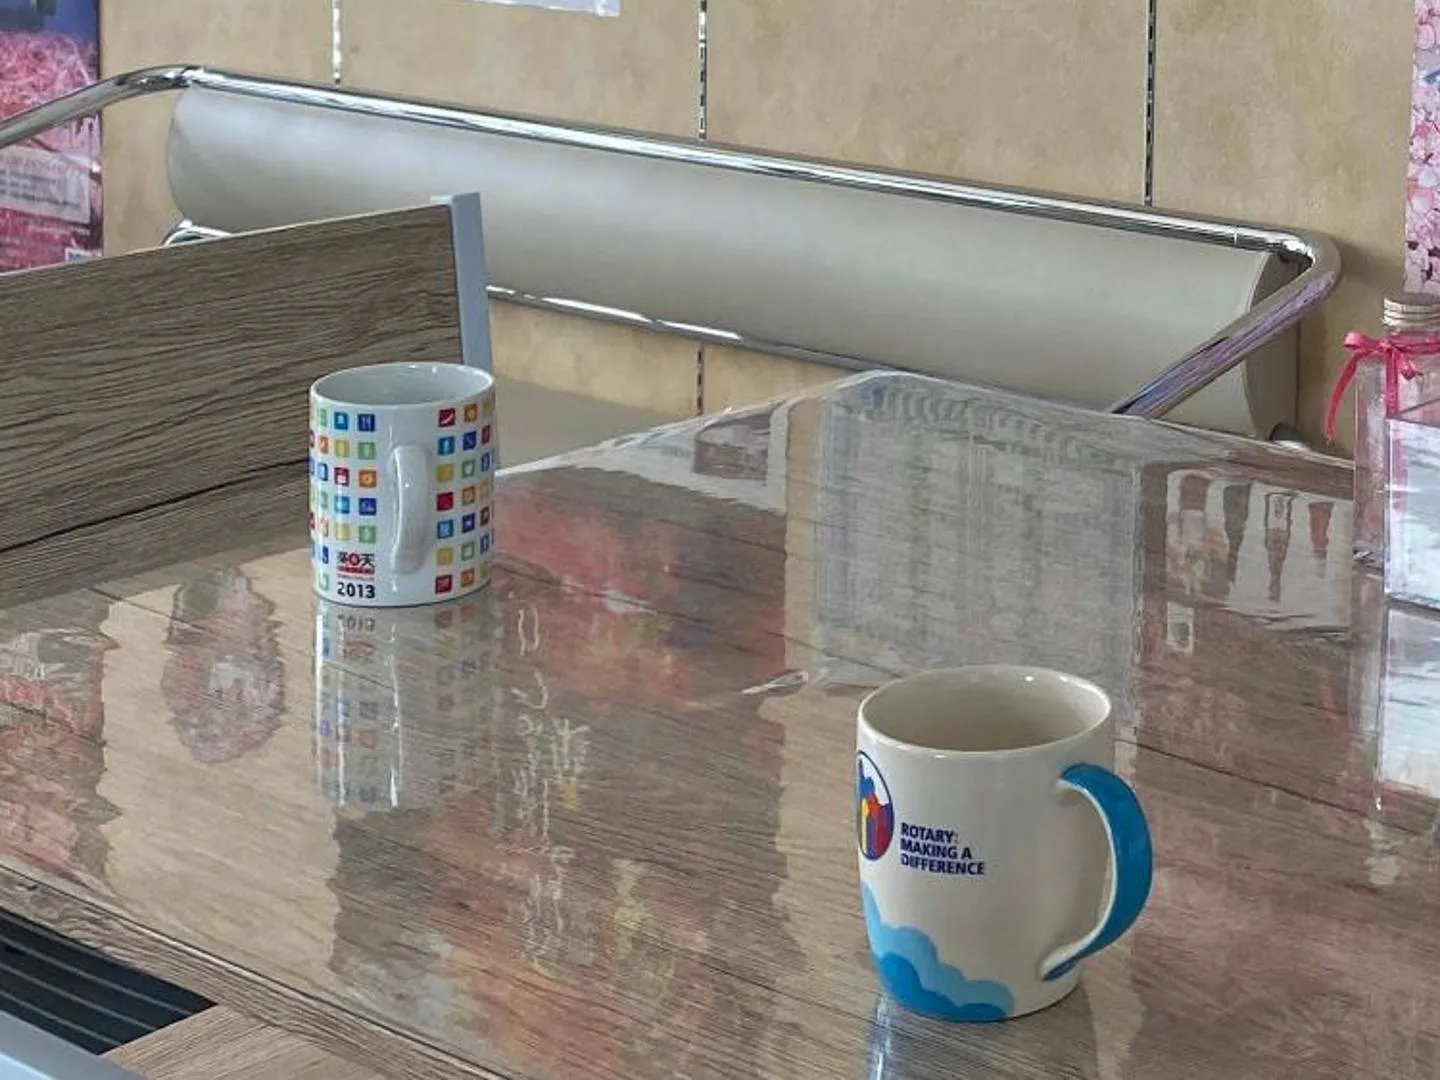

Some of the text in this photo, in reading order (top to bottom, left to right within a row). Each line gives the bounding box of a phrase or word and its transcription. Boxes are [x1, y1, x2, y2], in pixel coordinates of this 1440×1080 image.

[336, 581, 376, 599] 2013
[900, 837, 973, 860] MAKING A
[900, 853, 985, 876] DIFFERENCE
